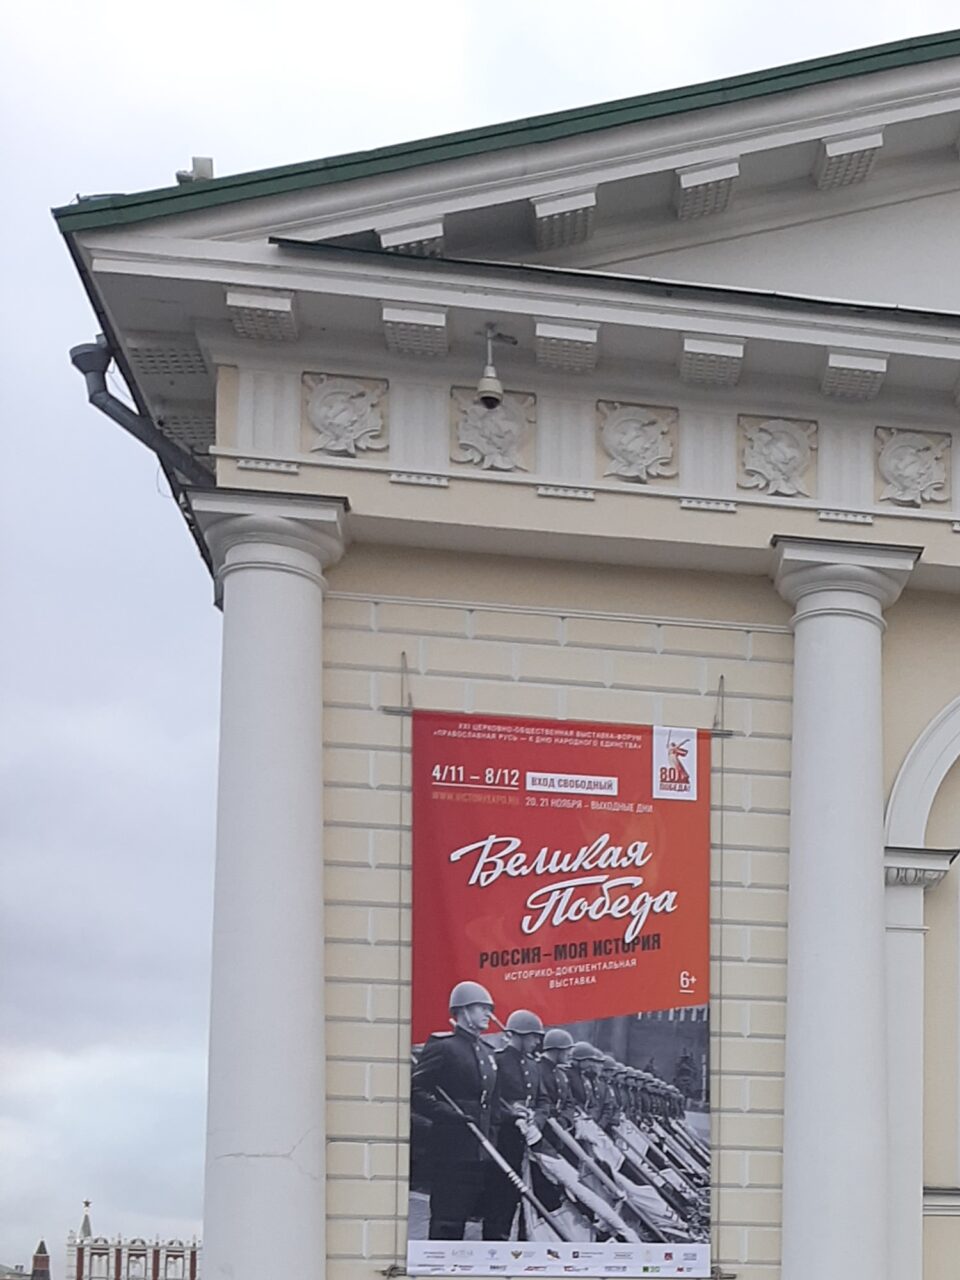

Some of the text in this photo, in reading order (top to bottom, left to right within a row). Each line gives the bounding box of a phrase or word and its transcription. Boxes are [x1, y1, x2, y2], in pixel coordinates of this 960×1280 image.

[432, 764, 464, 782] 4/11
[485, 767, 519, 786] 8/12
[531, 776, 613, 791] ВХОД СВОБОДНЫЙ
[539, 797, 549, 807] 21
[550, 798, 583, 809] НОЯБРЯ
[591, 800, 633, 813] ВЫХОДНЫЕ
[635, 803, 653, 813] ДНИ
[449, 833, 652, 887] Великая
[521, 874, 678, 944] Победа
[593, 934, 661, 956] ИСТОРИЯ
[504, 958, 637, 981] ИСТОРИКО-ДОКУМЕНТАЛЬНАЯ
[680, 971, 697, 988] 6+
[549, 975, 598, 989] ВЫСТАВКА
